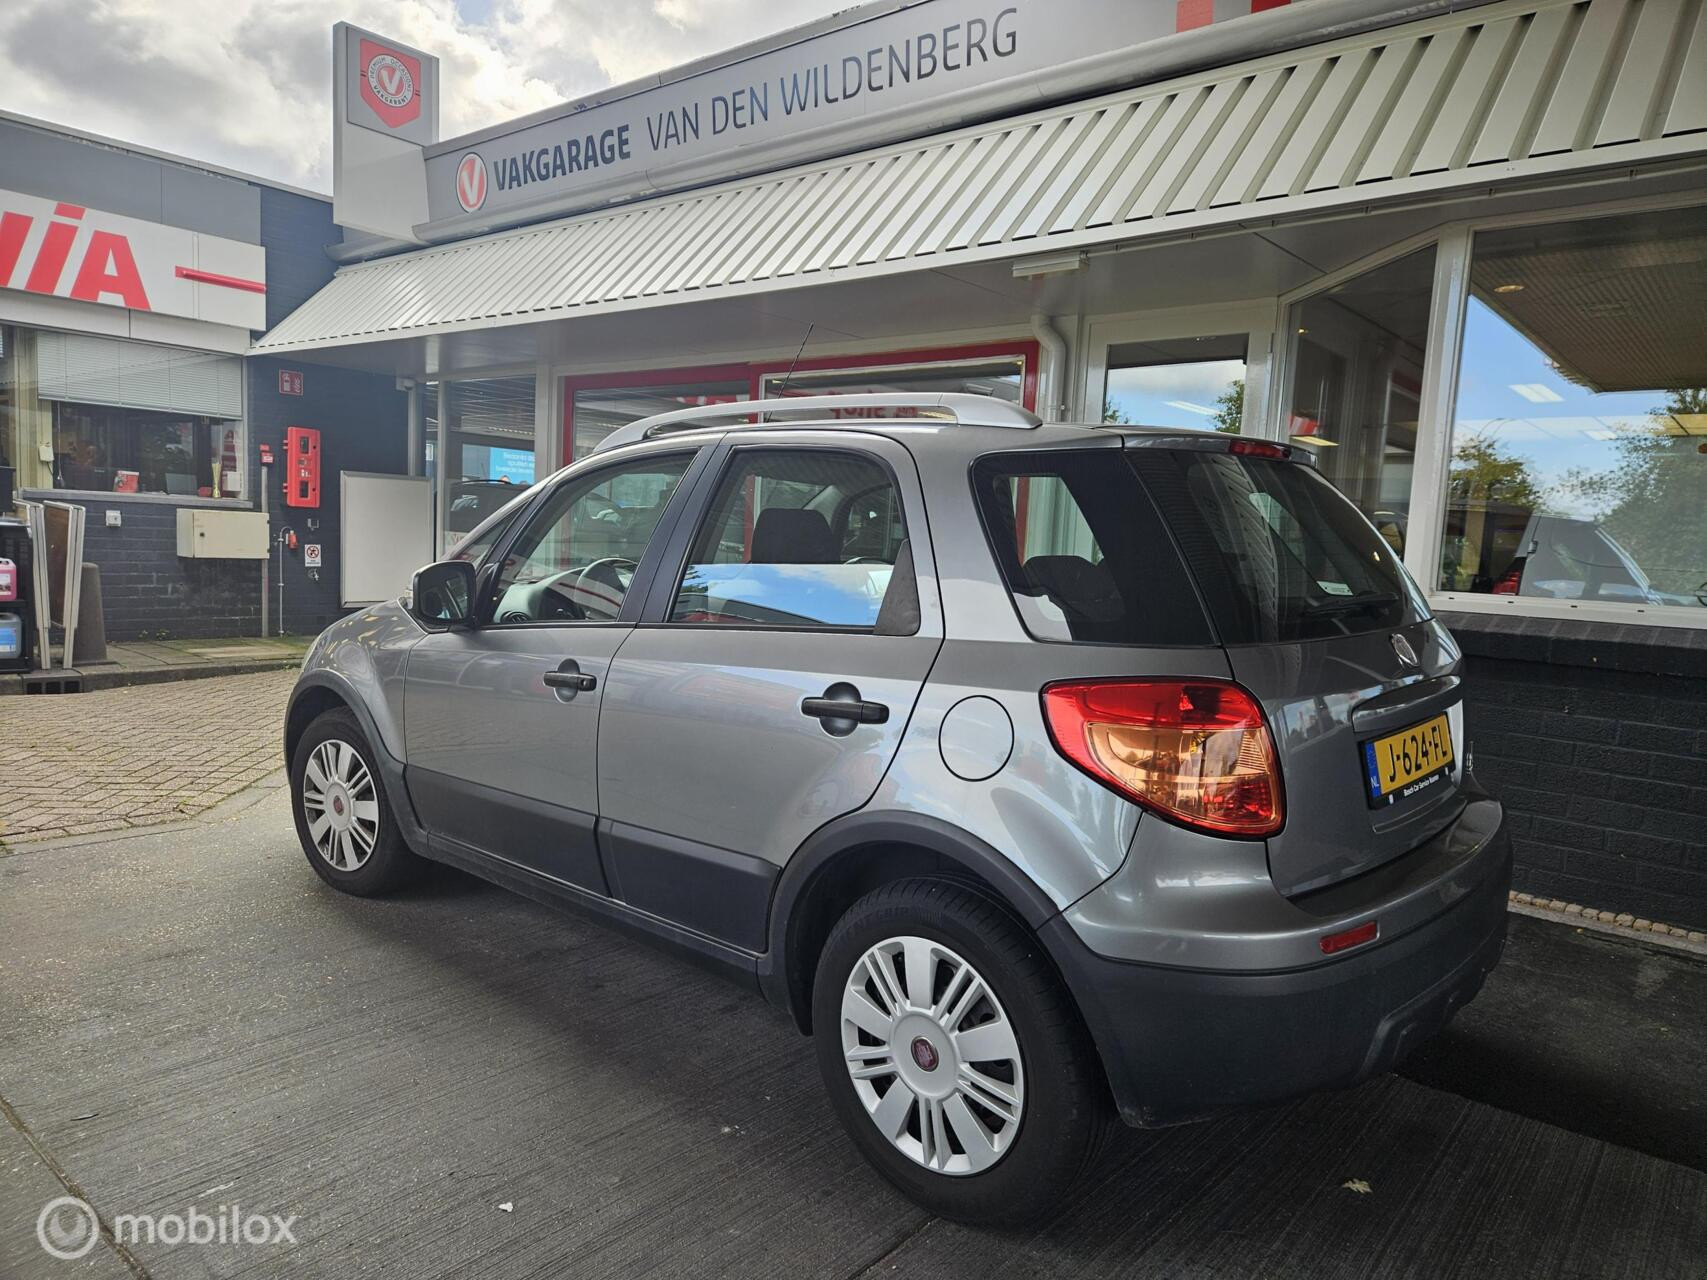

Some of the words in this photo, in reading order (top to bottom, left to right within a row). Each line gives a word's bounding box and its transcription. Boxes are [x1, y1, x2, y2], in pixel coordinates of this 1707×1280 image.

[493, 124, 631, 191] VAKGARAGE
[646, 101, 700, 151] VAN
[711, 82, 768, 136] DEN
[780, 7, 1017, 116] WILDENBERG
[1370, 776, 1380, 789] NL
[1388, 724, 1448, 783] J-624-FL
